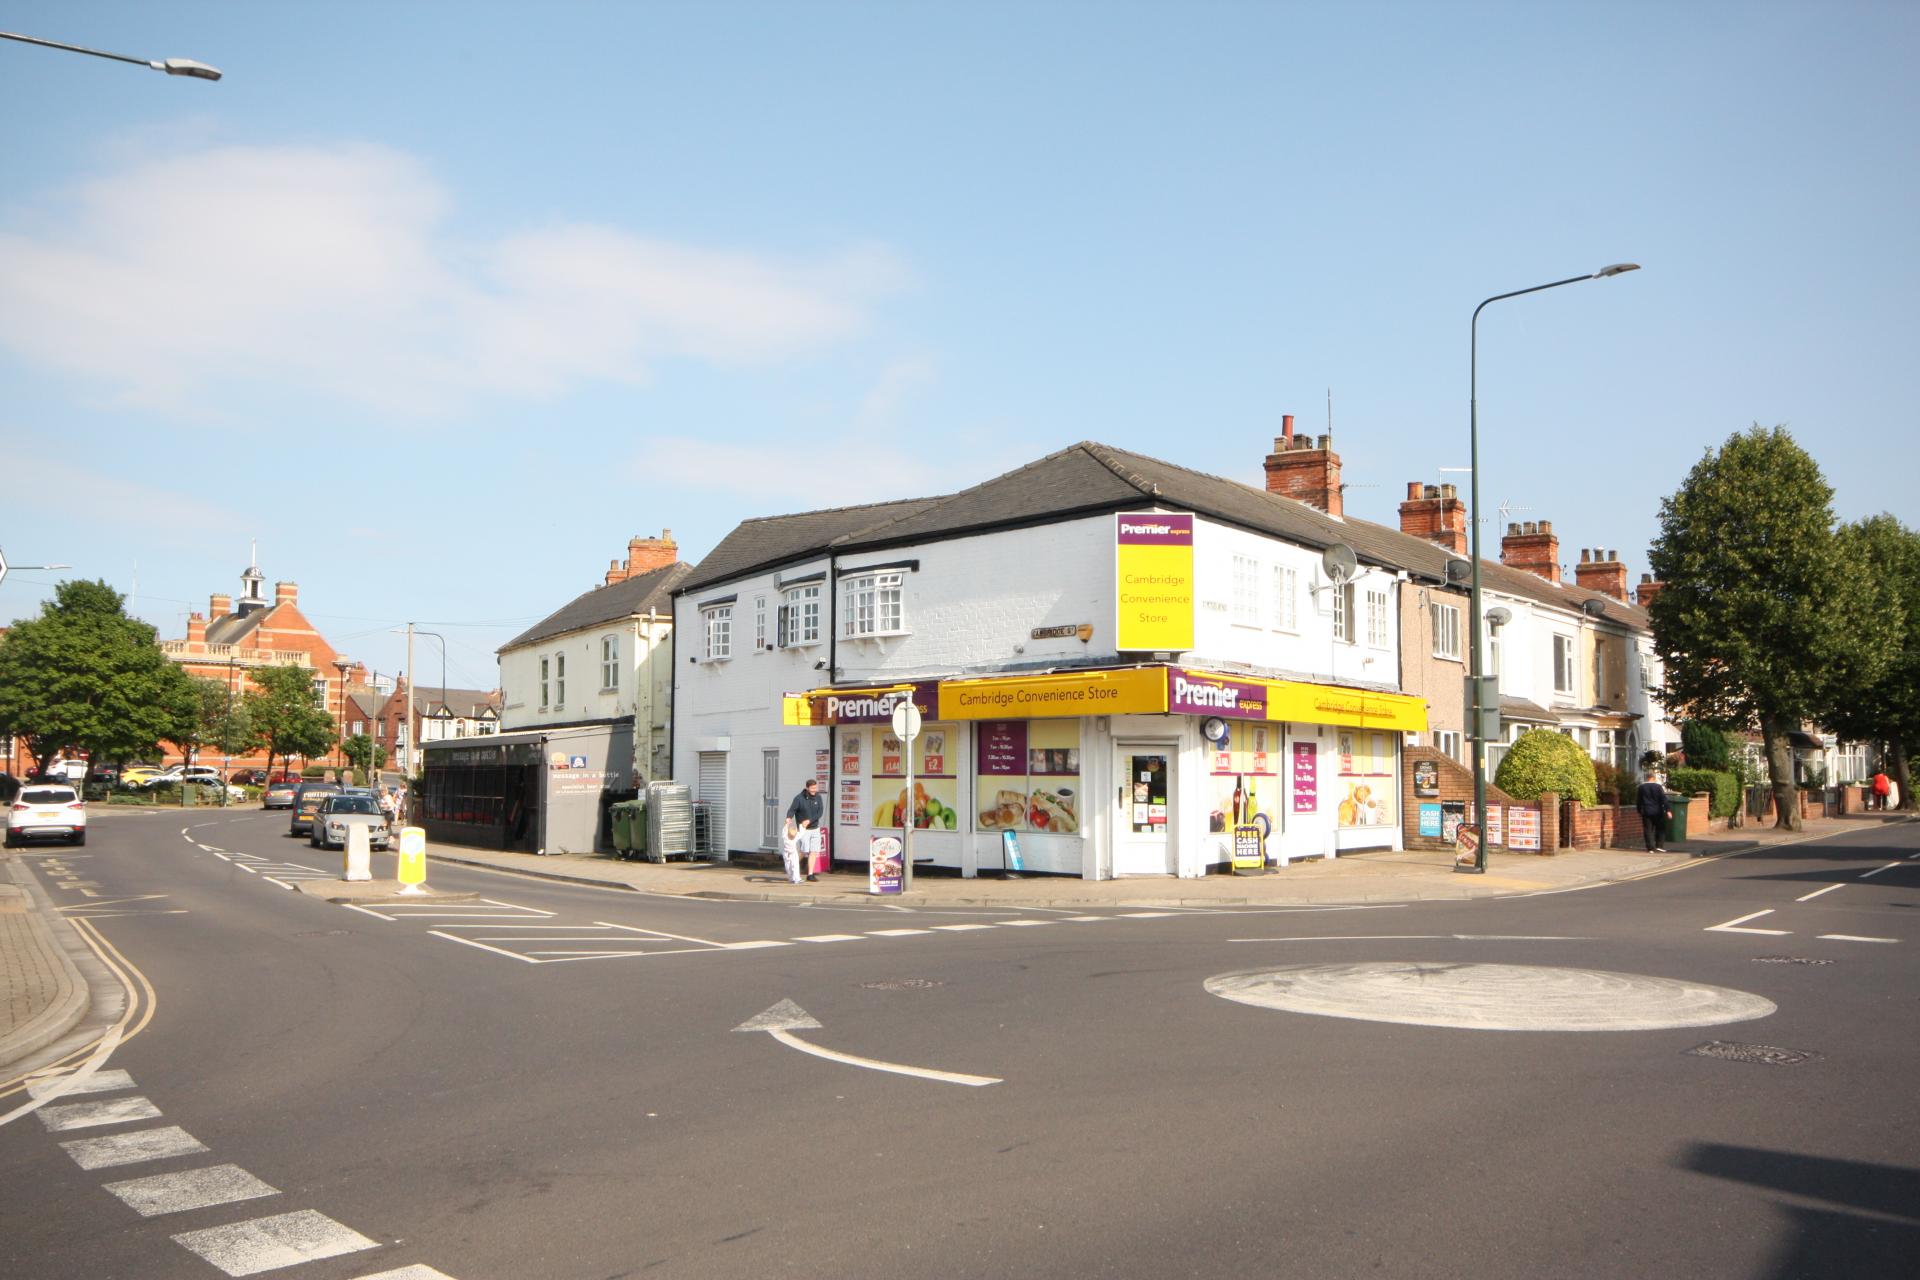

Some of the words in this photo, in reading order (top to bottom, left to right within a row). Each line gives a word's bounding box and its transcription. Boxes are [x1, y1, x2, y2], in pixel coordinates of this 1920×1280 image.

[1121, 523, 1171, 535] Premier
[1125, 574, 1185, 587] Cambridge
[1120, 593, 1190, 604] Convenience
[1139, 612, 1168, 623] Store
[959, 690, 1014, 707] Cambridge
[1016, 688, 1085, 703] Convenience
[1088, 686, 1118, 699] Store
[1175, 677, 1239, 708] Premier
[1239, 700, 1263, 714] express
[827, 697, 897, 718] Premier
[1421, 819, 1441, 827] HERE
[1236, 830, 1258, 838] FREE
[1236, 848, 1259, 856] HERE
